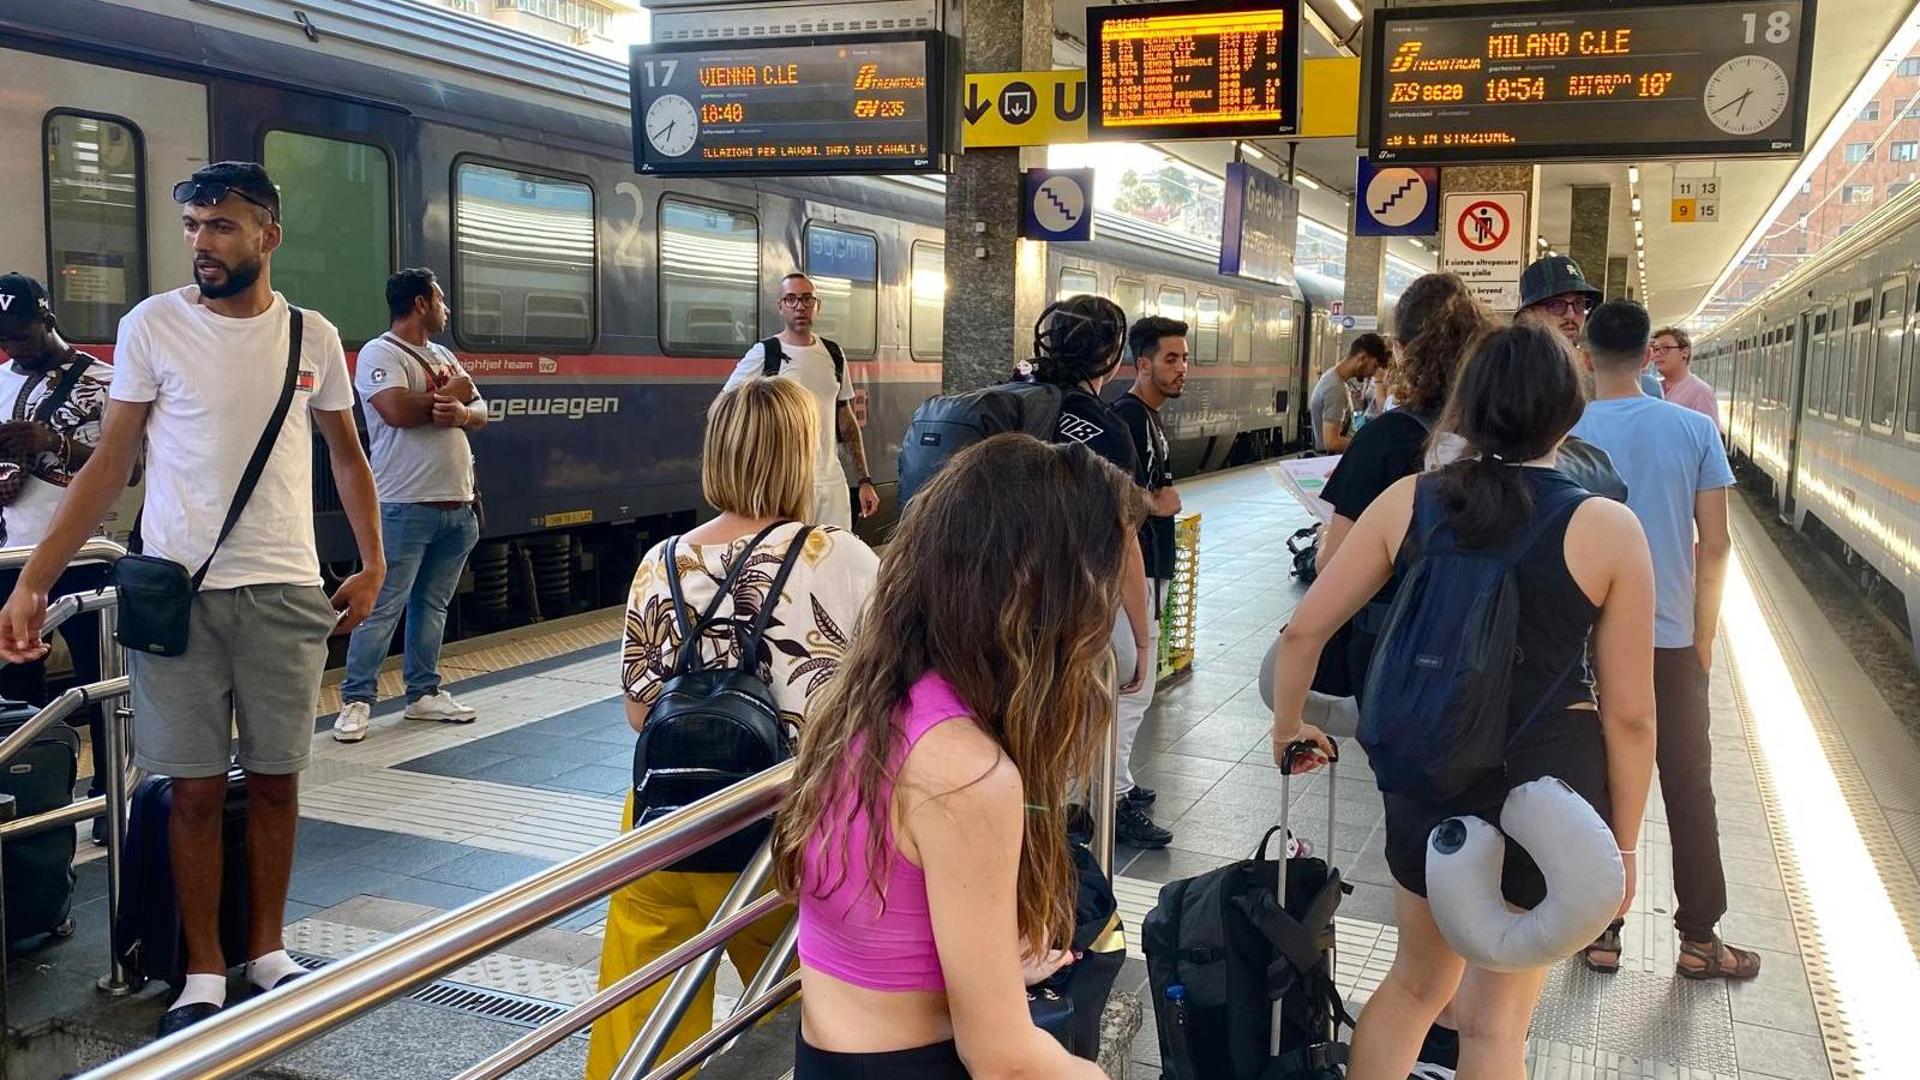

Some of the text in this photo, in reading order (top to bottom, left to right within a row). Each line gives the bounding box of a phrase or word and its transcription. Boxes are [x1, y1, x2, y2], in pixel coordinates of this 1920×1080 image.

[1742, 11, 1791, 44] 18
[1488, 29, 1631, 58] MILANO C.LE
[644, 60, 679, 87] 17
[699, 63, 798, 87] VIENNA C.LE
[1389, 83, 1463, 102] ES 8620
[1486, 77, 1544, 101] 18:54
[701, 103, 743, 123] 18:40
[1055, 82, 1086, 121] U
[758, 147, 777, 157] PER
[825, 144, 850, 155] INFO
[855, 144, 873, 155] SUI
[877, 143, 915, 154] CANALI
[1247, 175, 1284, 220] Genova
[1680, 183, 1716, 194] 11 13
[1679, 204, 1714, 217] 9 15
[614, 182, 646, 267] 2
[504, 359, 533, 370] team
